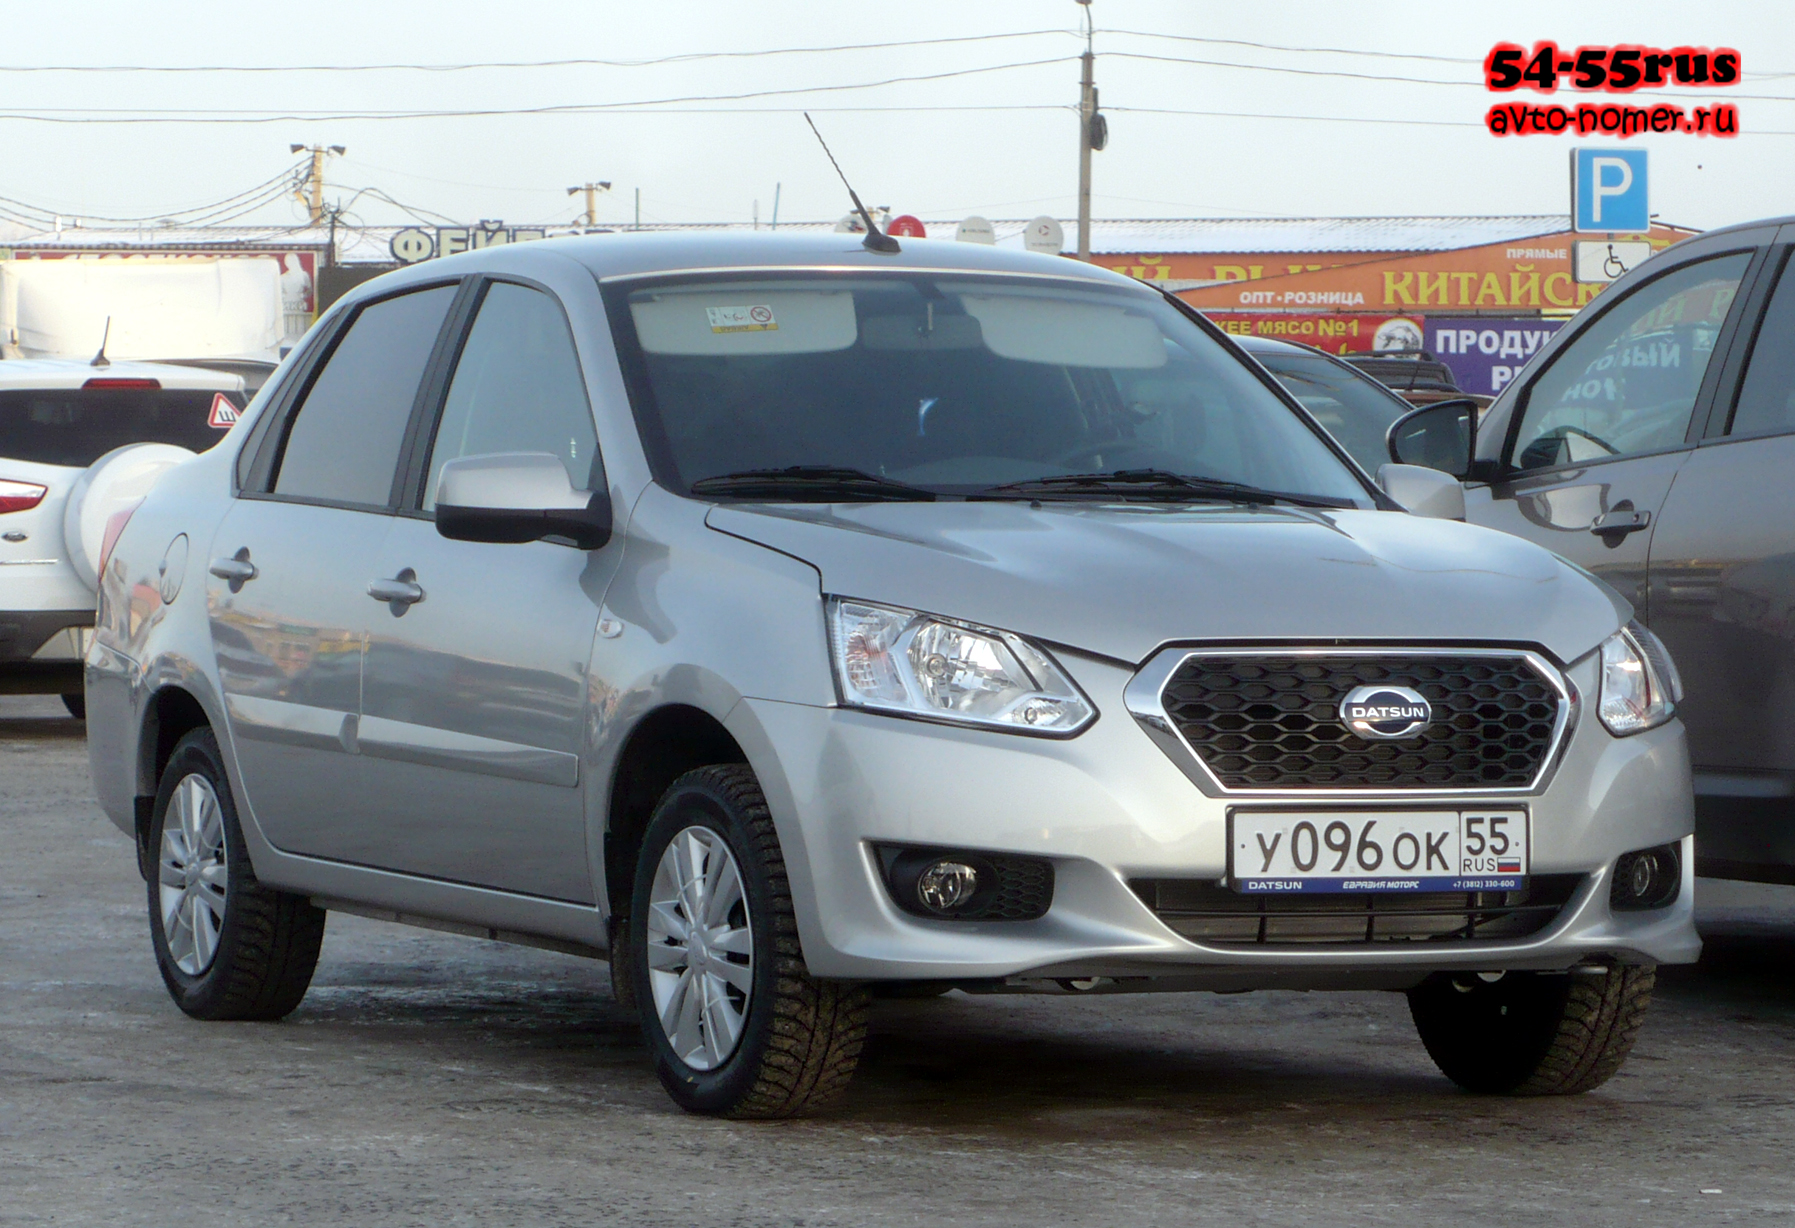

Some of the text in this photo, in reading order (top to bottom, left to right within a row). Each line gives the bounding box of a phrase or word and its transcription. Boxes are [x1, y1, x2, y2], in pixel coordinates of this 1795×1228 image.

[1592, 157, 1633, 222] P
[1506, 247, 1568, 260] ПРЯМЫЕ
[1239, 291, 1366, 306] ОПТ РОЗНИЦА
[1257, 320, 1314, 335] МЯСО
[1318, 318, 1360, 337] №1
[1351, 706, 1425, 718] DATSUN
[1465, 816, 1510, 856] 55
[1462, 857, 1496, 872] RUS
[1248, 881, 1303, 890] DATSUN
[1386, 880, 1420, 889] МОТОРС
